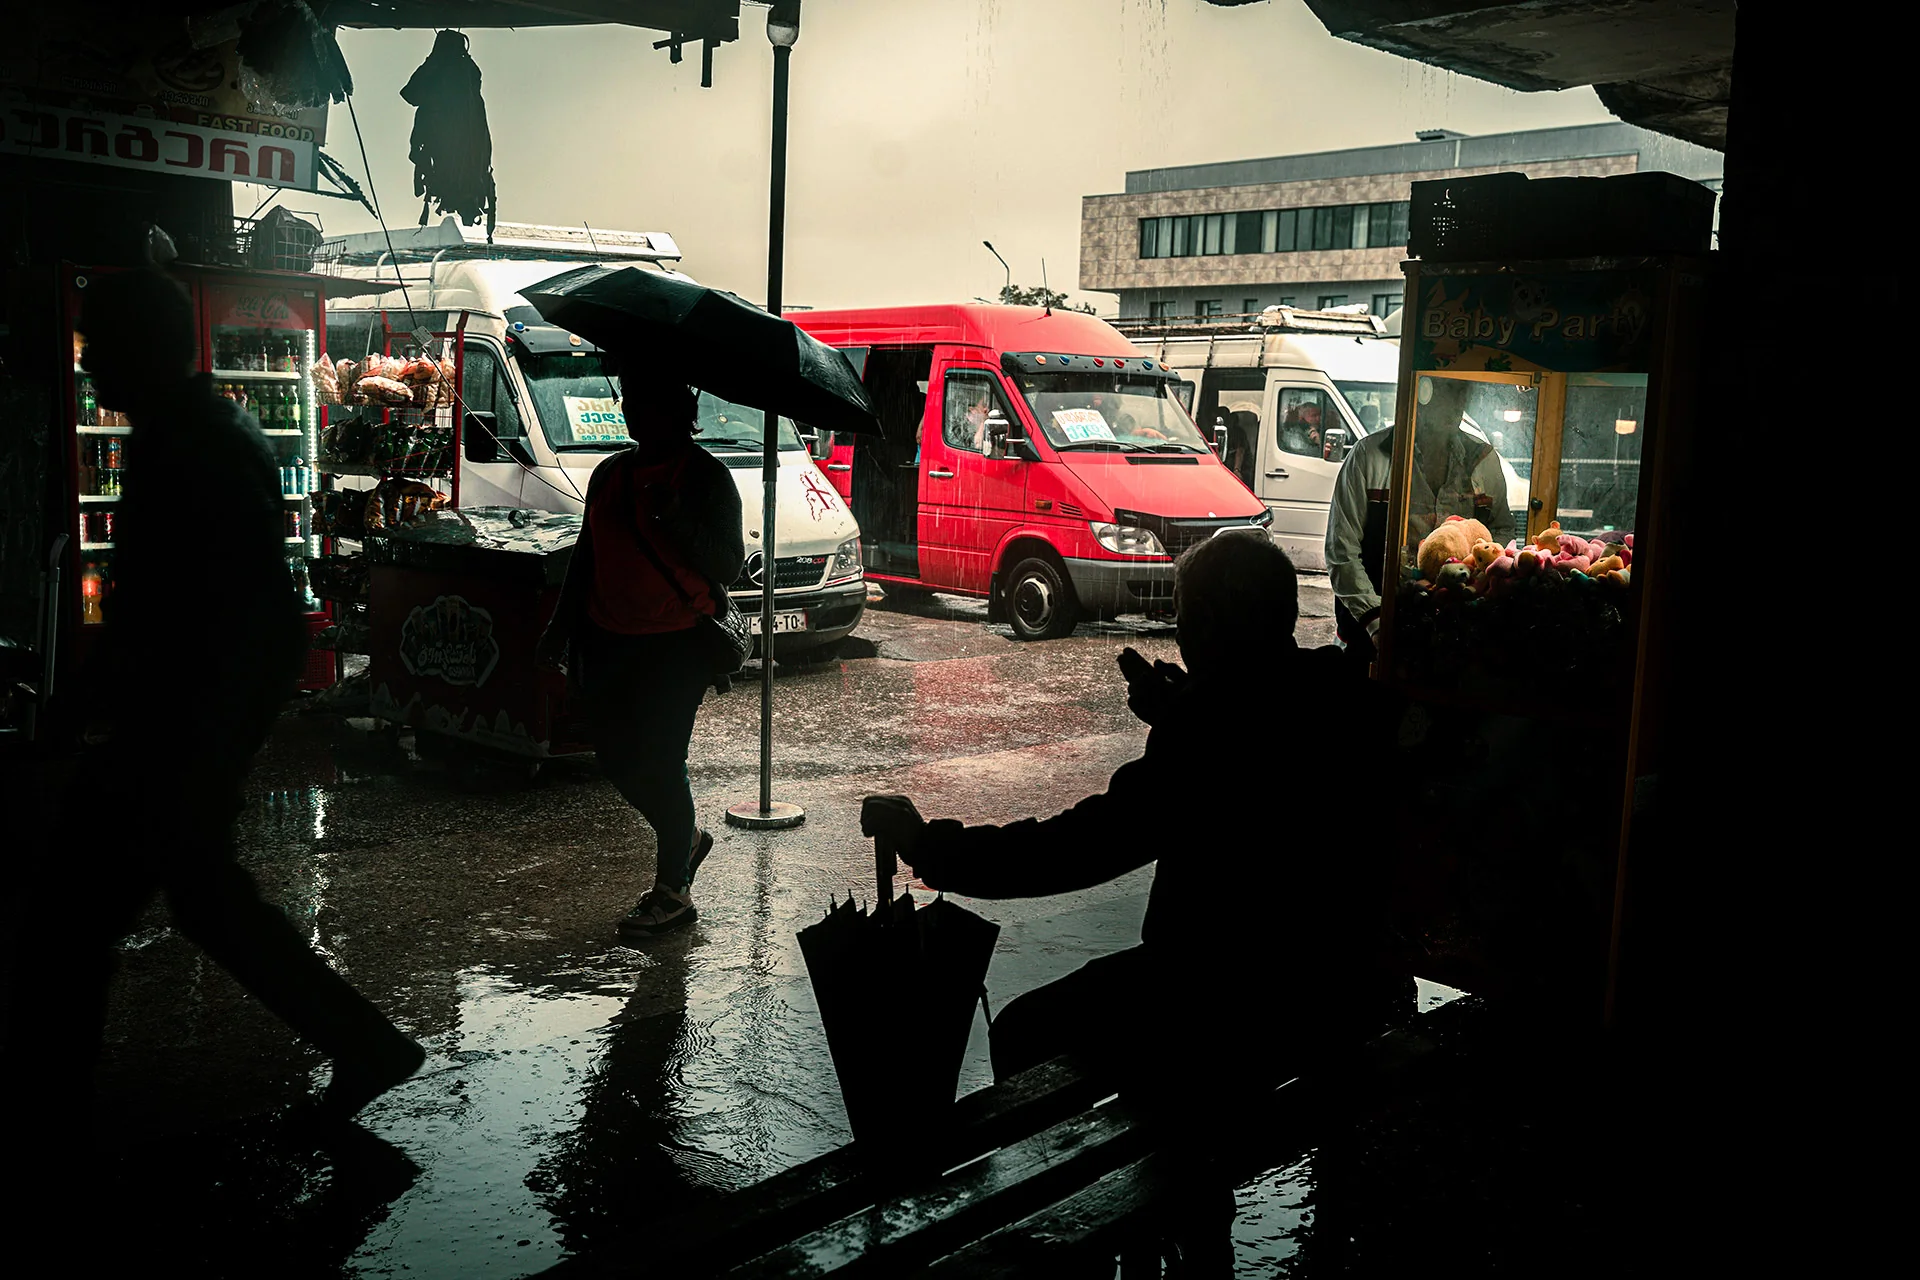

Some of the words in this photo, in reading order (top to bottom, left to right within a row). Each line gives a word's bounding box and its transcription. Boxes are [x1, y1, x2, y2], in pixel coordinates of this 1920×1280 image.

[198, 113, 252, 133] FAST
[258, 121, 315, 143] FOOD
[0, 108, 296, 183] ურგერი
[1421, 307, 1516, 346] Baby
[1530, 307, 1648, 345] Party
[575, 423, 628, 435] ბათუმ
